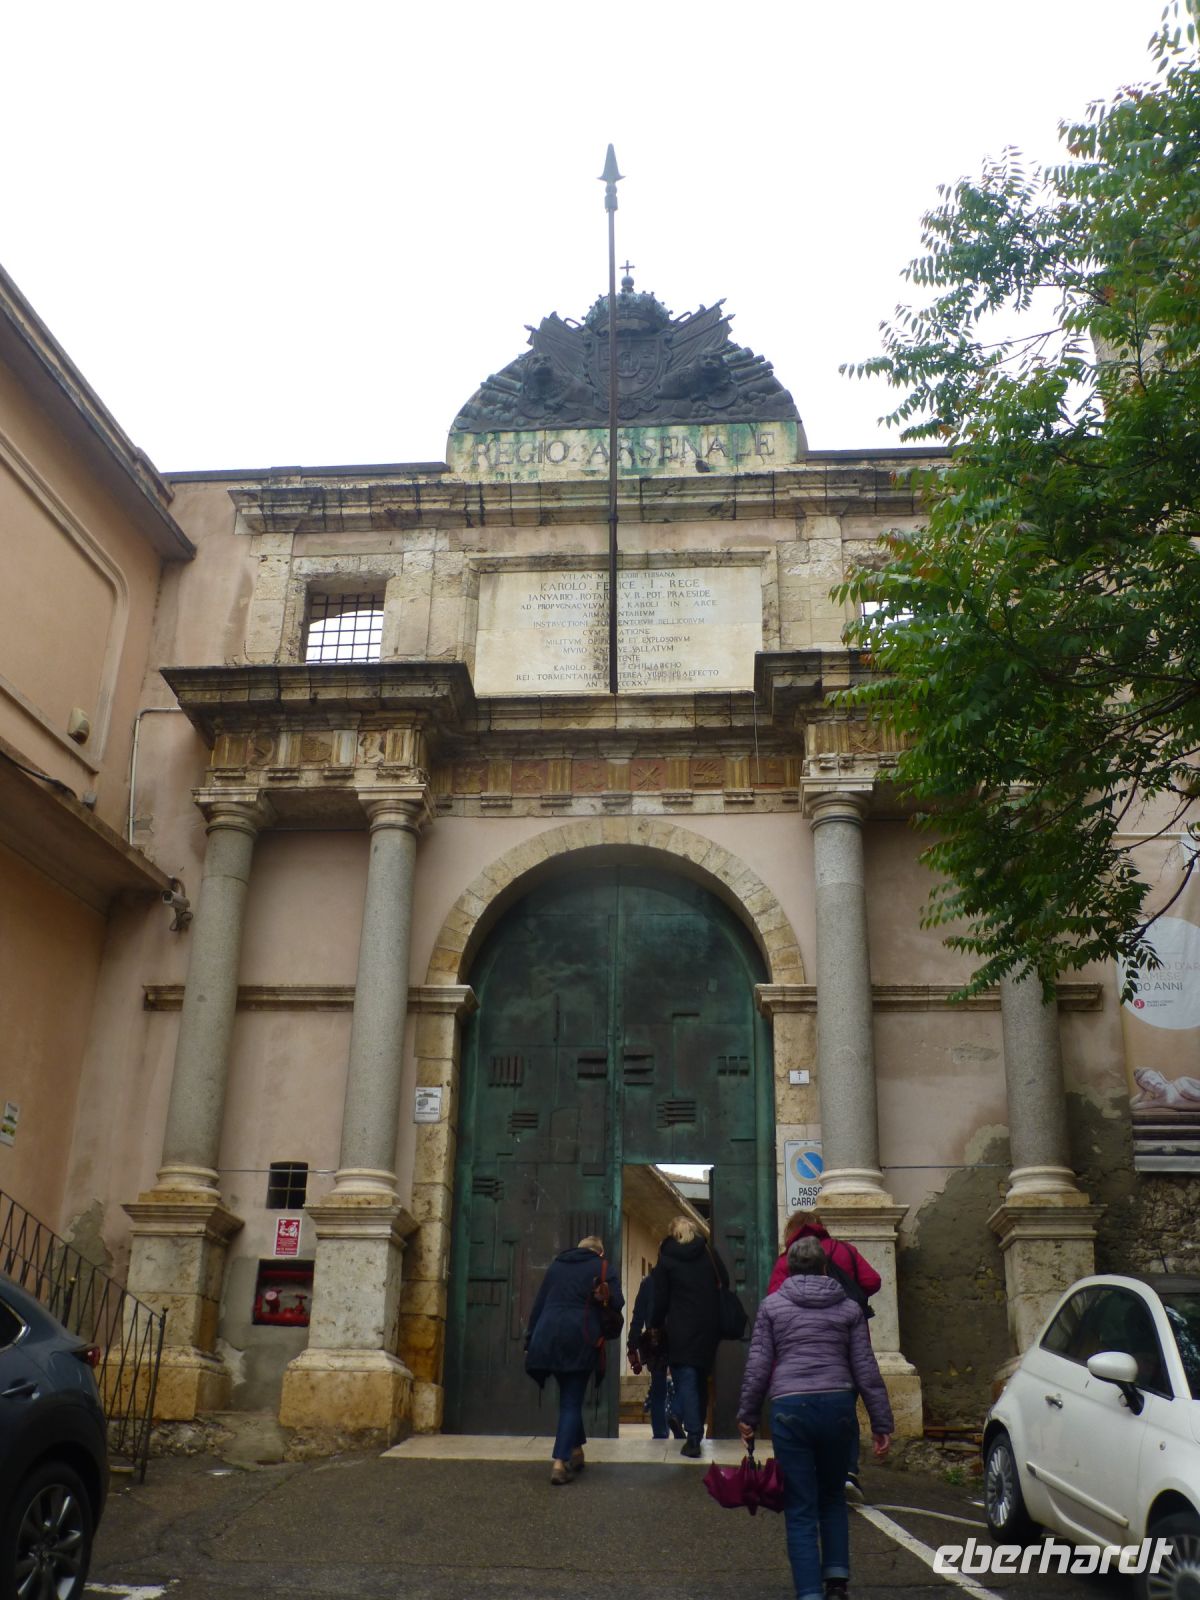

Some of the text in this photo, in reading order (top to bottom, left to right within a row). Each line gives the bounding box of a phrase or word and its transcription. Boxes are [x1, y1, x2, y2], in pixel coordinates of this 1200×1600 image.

[472, 432, 775, 467] REGIO ARSENALE
[540, 578, 700, 591] KAROLO FEICE I REGE
[667, 589, 711, 599] PRAESIDE
[583, 610, 655, 618] ARMANTARIVM
[596, 618, 654, 627] TOENTORVM
[1136, 982, 1183, 991] 00 ANNI
[792, 1196, 817, 1207] CARRA
